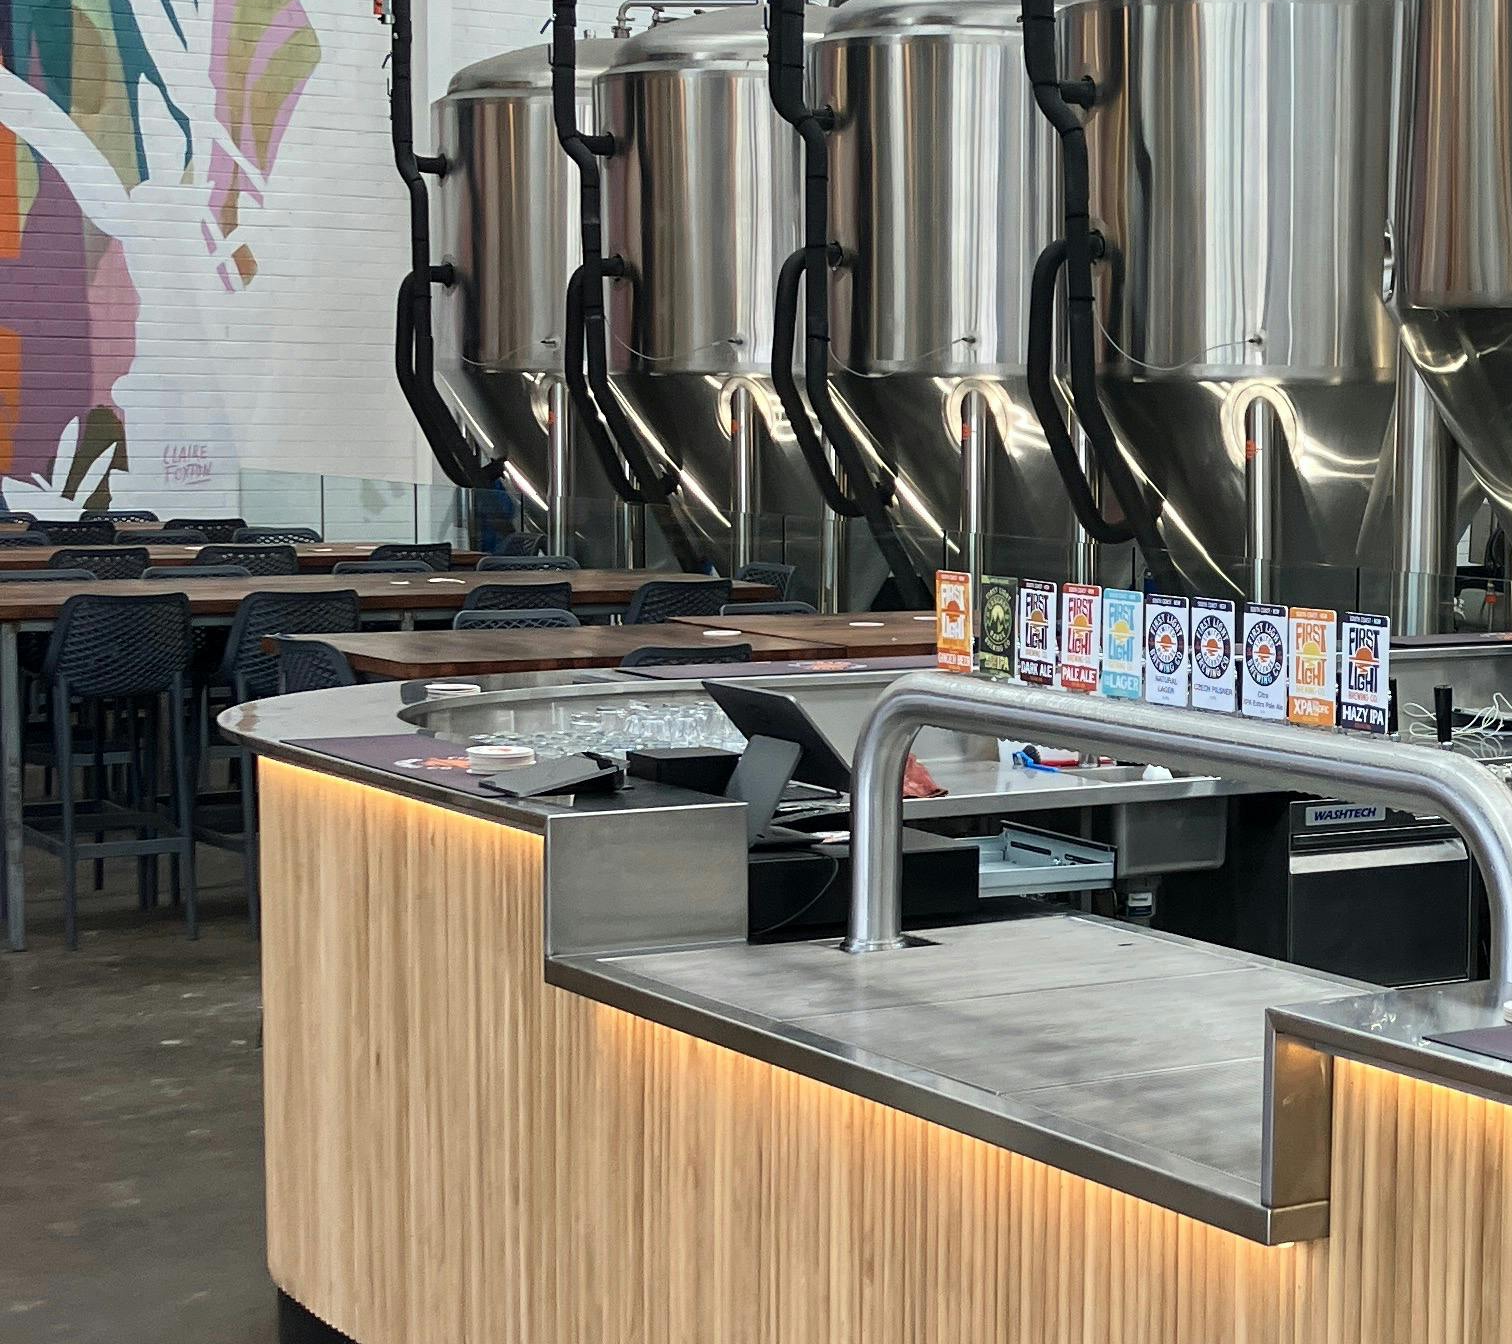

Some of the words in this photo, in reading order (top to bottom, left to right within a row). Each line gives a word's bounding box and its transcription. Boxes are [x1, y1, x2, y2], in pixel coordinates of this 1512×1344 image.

[163, 444, 208, 464] CLAIRE
[1026, 593, 1049, 621] FIRST
[1068, 598, 1093, 627] FIRST
[1109, 603, 1135, 633] FIRST
[1026, 623, 1048, 650] LIGHT
[1150, 614, 1165, 636] FIRST
[1166, 613, 1183, 637] LIGHT
[1196, 617, 1211, 639] FIRST
[1212, 617, 1230, 641] LIGHT
[1248, 623, 1264, 645] FIRST
[1265, 622, 1282, 647] LIGHT
[1296, 623, 1327, 653] FIRST
[1068, 628, 1093, 655] LIGHT
[1109, 635, 1135, 662] LIGHT
[1349, 627, 1381, 659] FIRST
[1022, 661, 1038, 674] DARK
[1040, 664, 1053, 677] ALE
[1149, 648, 1175, 673] BREWING
[1175, 651, 1183, 668] CO
[1196, 652, 1221, 678] BREWING
[1221, 655, 1229, 671] CO
[1247, 658, 1273, 685] BREWING
[1273, 662, 1282, 677] CO
[1295, 656, 1327, 686] LIGHT
[1062, 667, 1079, 681] PALE
[1081, 670, 1095, 683] ALE
[1110, 673, 1139, 692] LAGER
[1348, 661, 1380, 693] LIGHT
[1294, 699, 1313, 716] XPA
[1342, 705, 1368, 723] HAZY
[1369, 709, 1384, 726] IPA
[1314, 807, 1376, 821] WASHTECH
